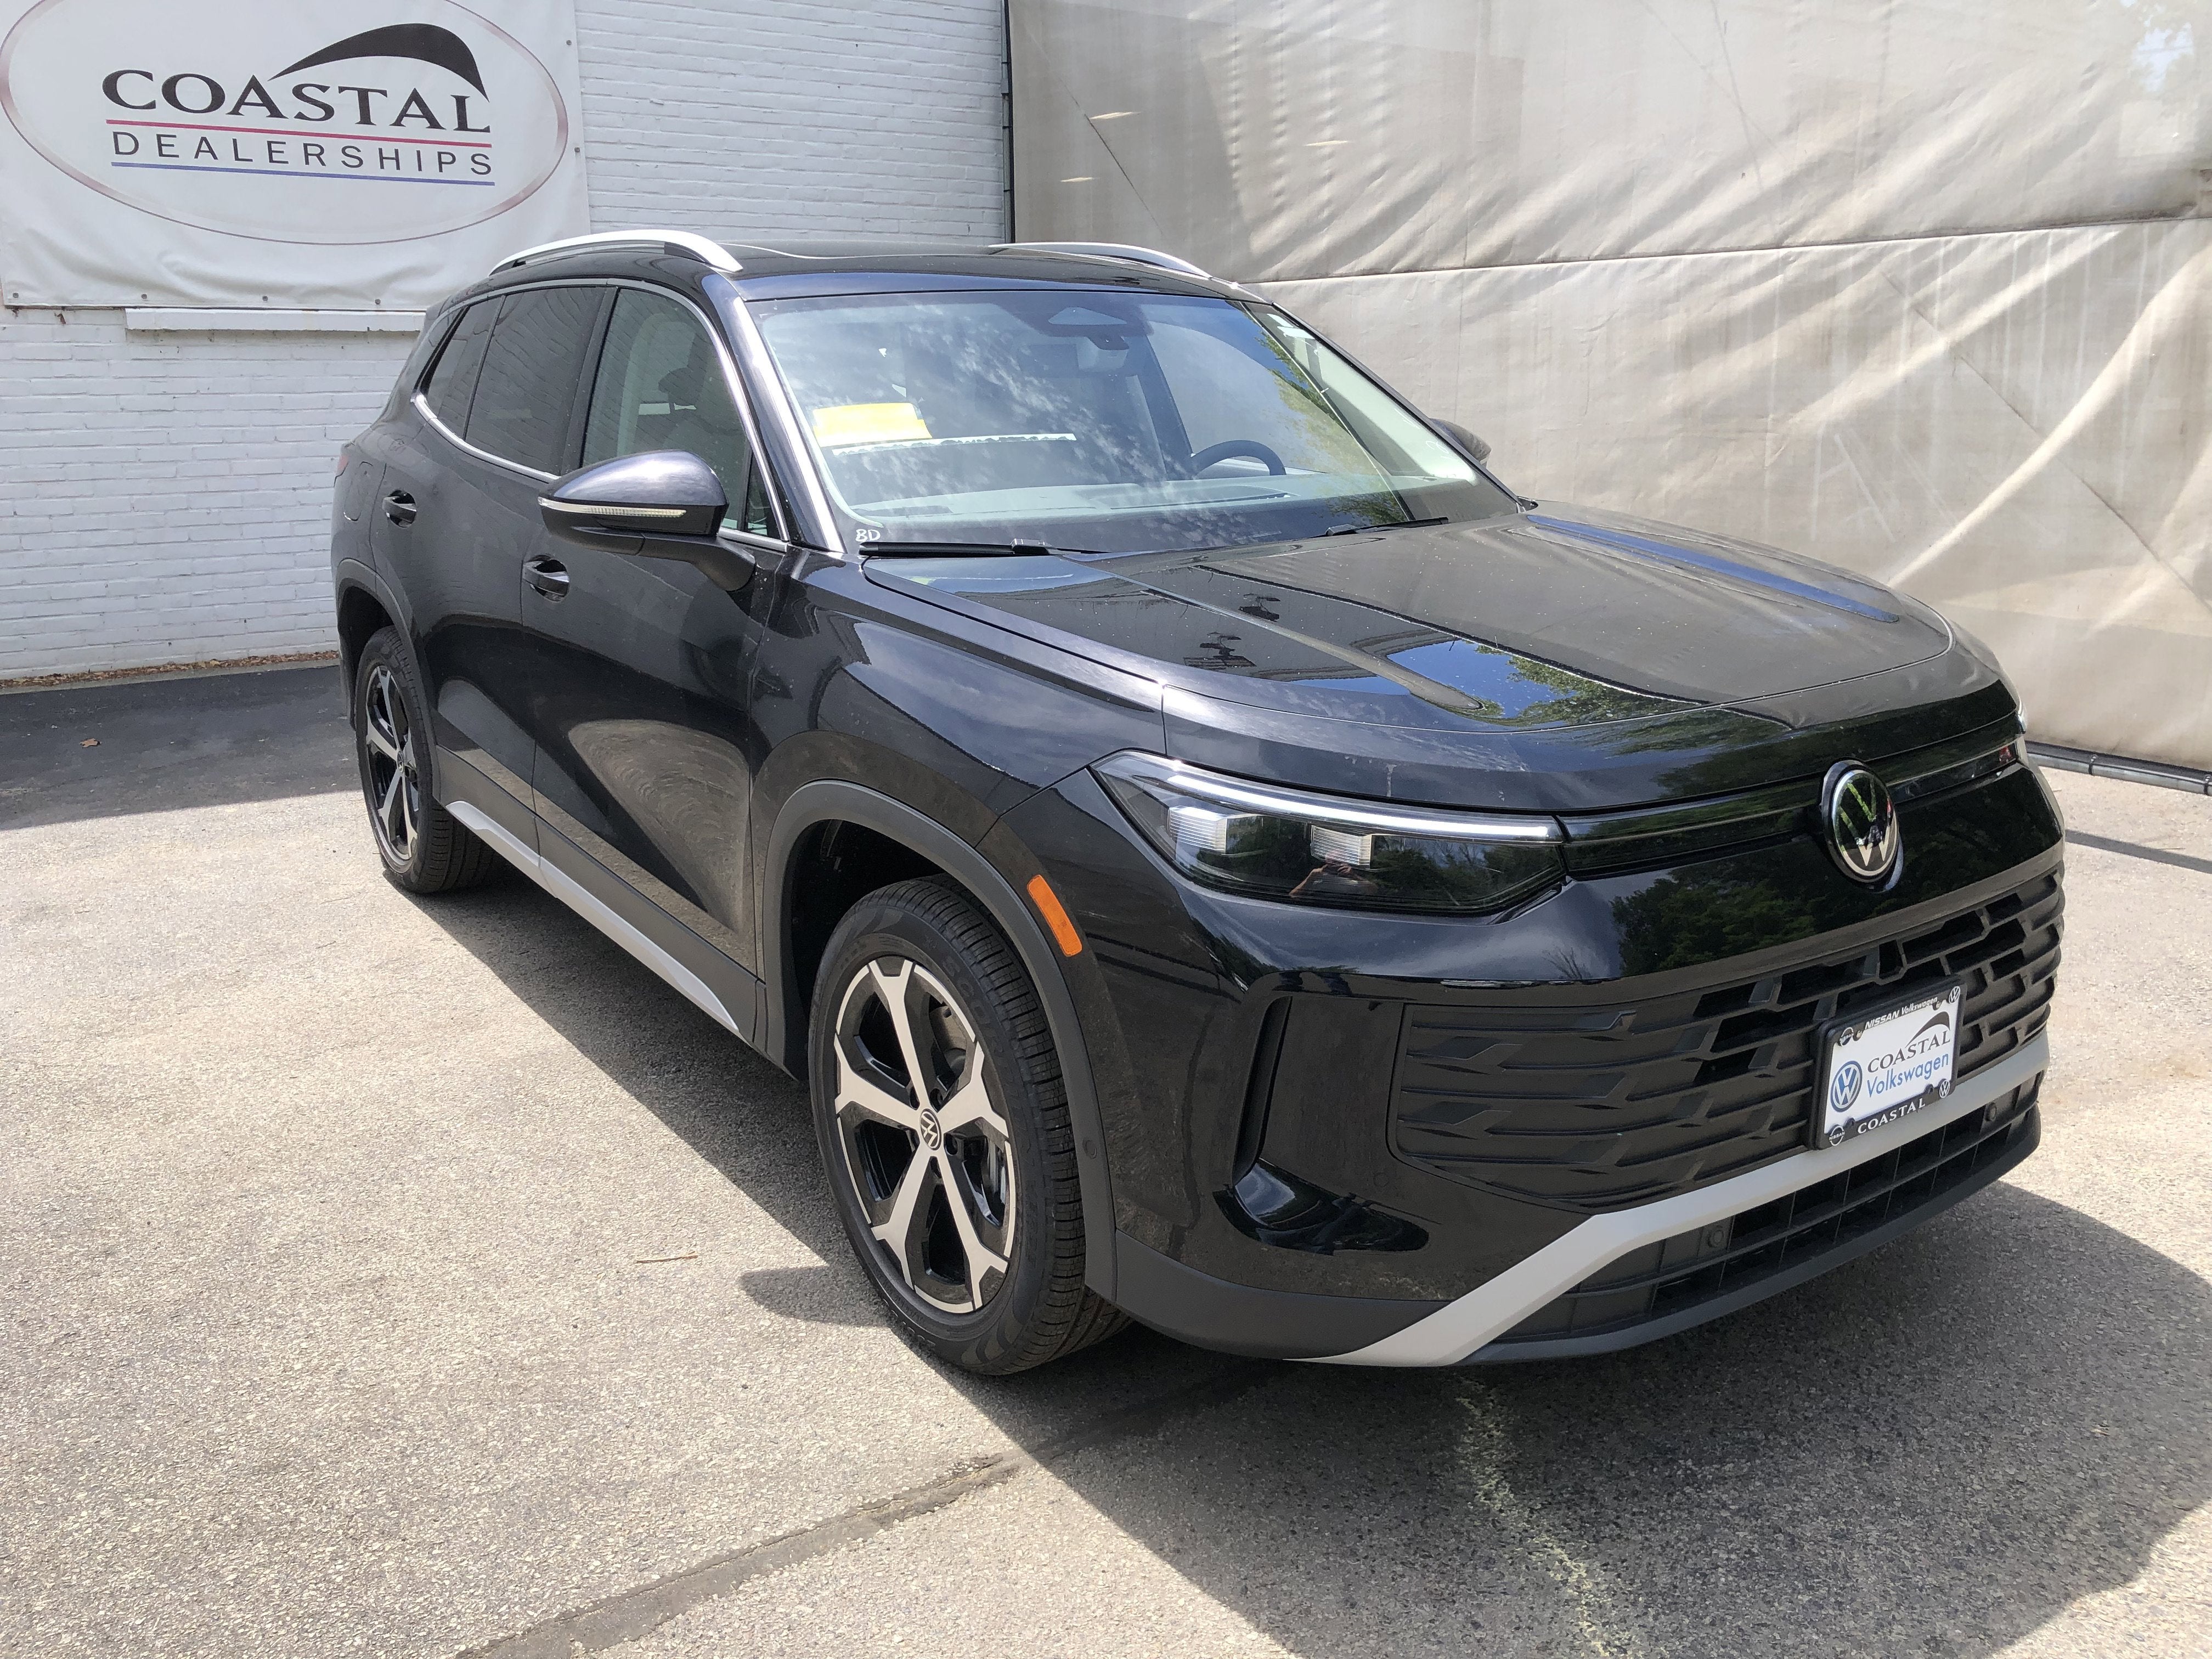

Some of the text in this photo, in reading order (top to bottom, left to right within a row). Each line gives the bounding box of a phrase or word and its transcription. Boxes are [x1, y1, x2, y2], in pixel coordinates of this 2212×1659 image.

[103, 69, 490, 133] COASTAL
[112, 131, 491, 176] DEALERSHIPS
[1865, 996, 1938, 1030] NISSAN Volkswagen
[1867, 1030, 1951, 1073] COASTAL
[1867, 1053, 1949, 1097] Volkswagen
[1858, 1098, 1926, 1134] COASTAL
